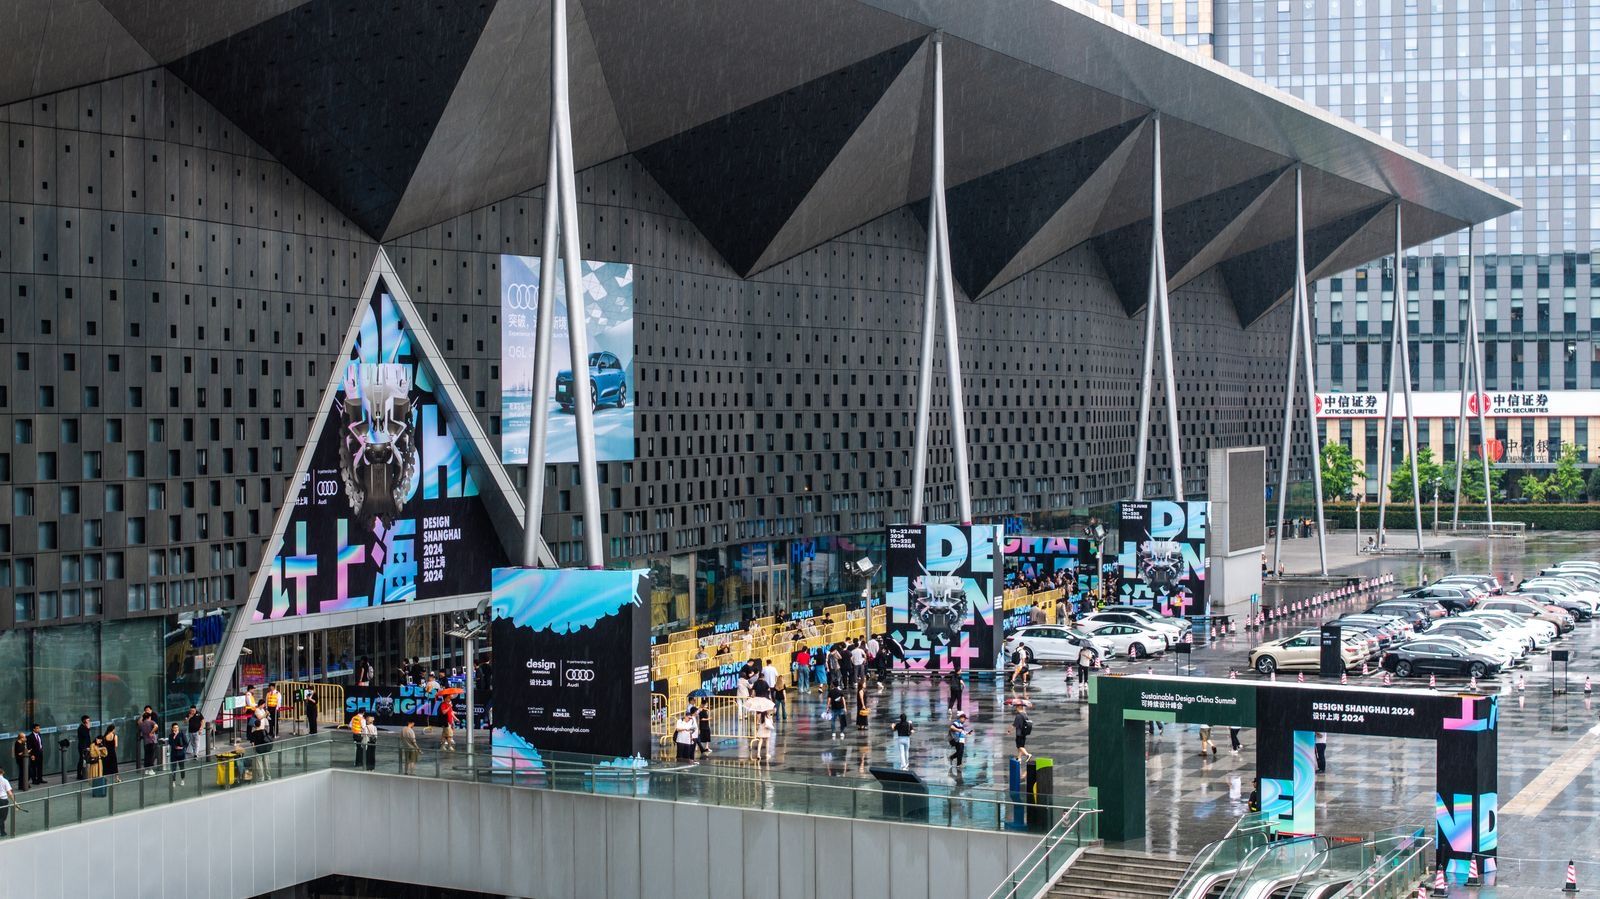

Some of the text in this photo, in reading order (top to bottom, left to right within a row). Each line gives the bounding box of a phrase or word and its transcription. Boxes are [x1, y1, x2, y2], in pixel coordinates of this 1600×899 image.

[1324, 395, 1378, 408] 中信证券
[1494, 394, 1549, 407] 中信证券
[423, 515, 450, 529] DESIGN
[423, 528, 461, 543] SHANGHAI
[423, 543, 443, 556] 2024
[423, 555, 446, 570] 设计上海
[423, 569, 443, 583] 2024
[526, 658, 556, 670] design
[1141, 691, 1237, 705] Sustainable Design China Summit
[1141, 700, 1183, 710] 可持续设计峰会
[1312, 703, 1415, 716] DESIGN SHANGHAI 2024
[1312, 712, 1365, 722] 设计上海 2024
[533, 725, 590, 734] www.designshanghai.com
